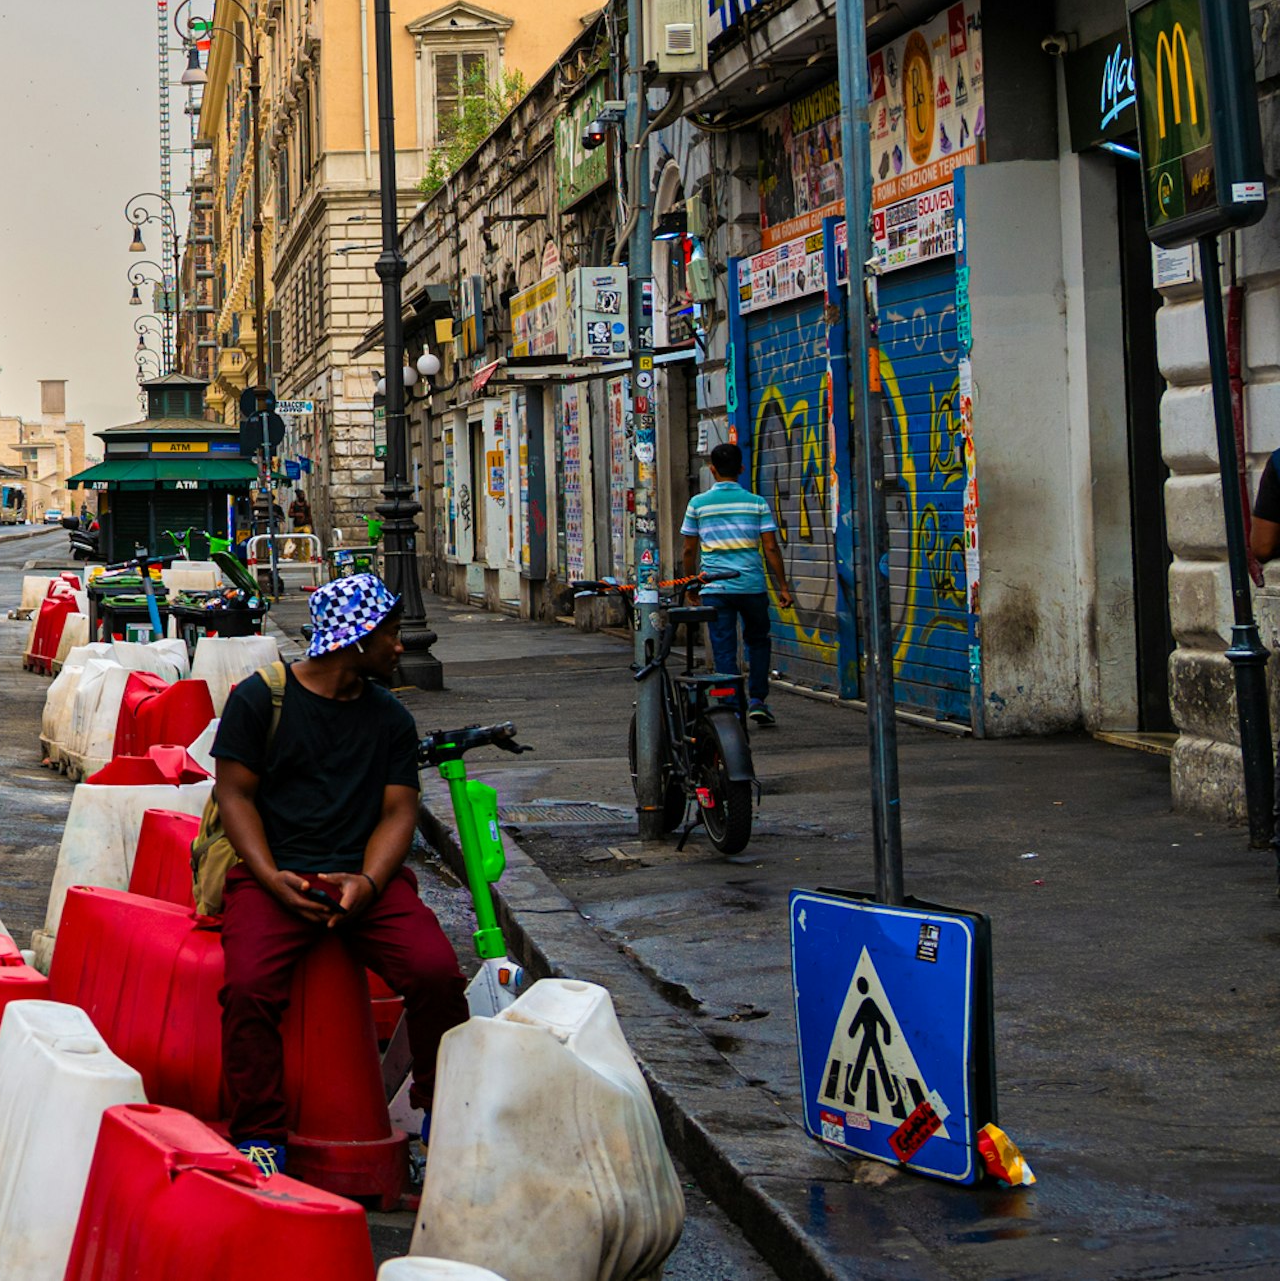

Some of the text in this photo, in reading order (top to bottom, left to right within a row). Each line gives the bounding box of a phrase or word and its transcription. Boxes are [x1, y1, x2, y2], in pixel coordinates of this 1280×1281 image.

[877, 180, 896, 201] ROMA
[771, 229, 781, 242] VIA
[781, 216, 809, 238] GIOVANNI
[641, 358, 651, 368] R
[169, 443, 190, 451] ATM
[92, 482, 108, 490] ATM
[175, 481, 198, 489] ATM
